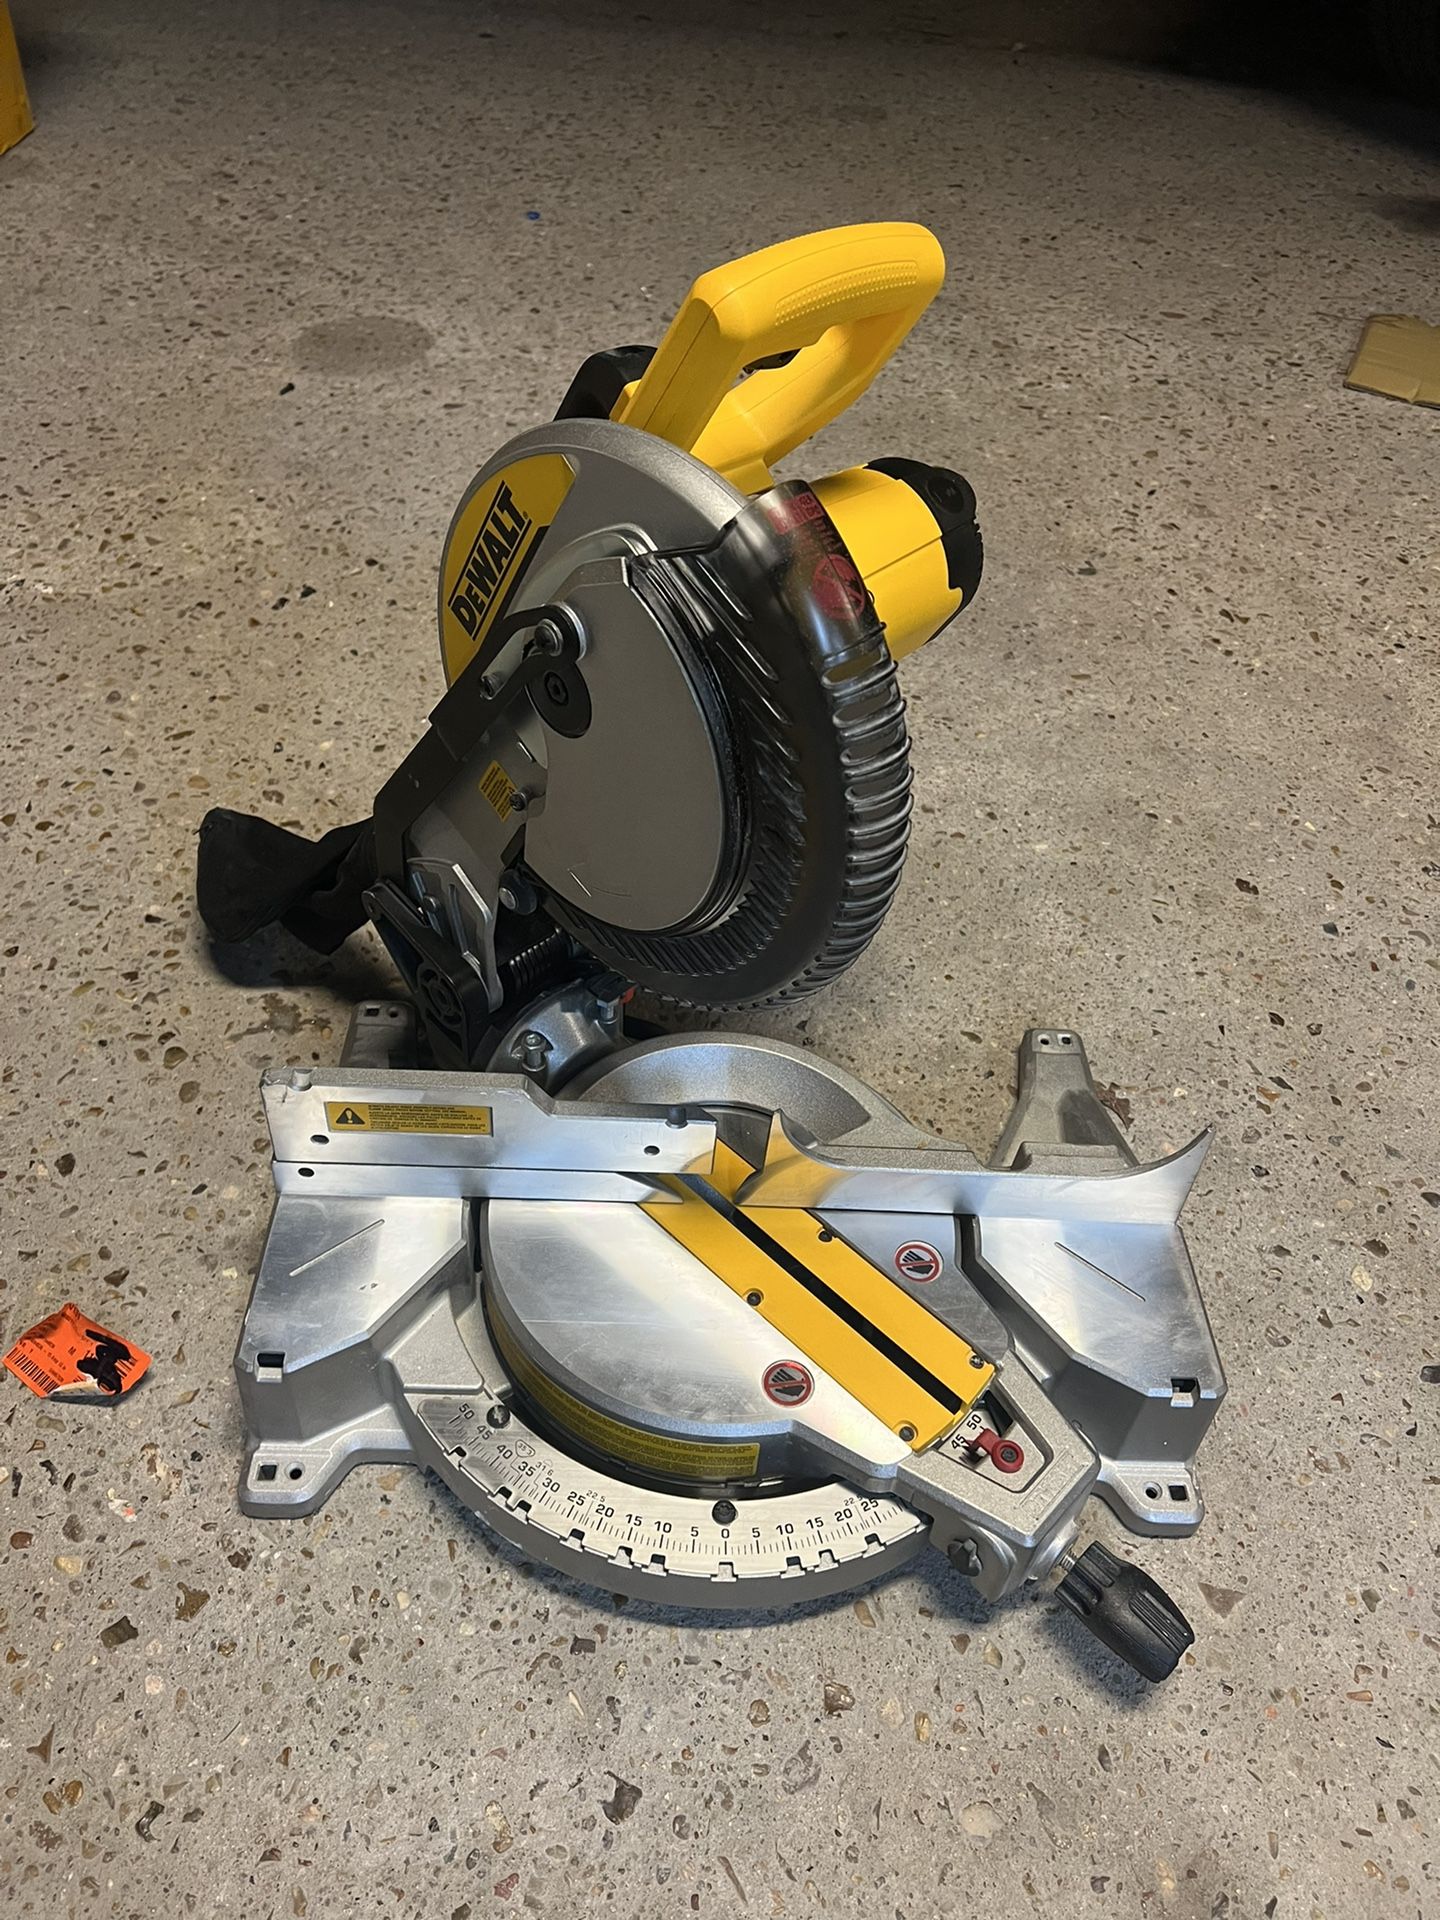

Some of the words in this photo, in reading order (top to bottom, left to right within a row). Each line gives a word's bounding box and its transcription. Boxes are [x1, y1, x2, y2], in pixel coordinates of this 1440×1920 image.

[451, 485, 526, 637] DEWALT
[967, 1414, 982, 1430] 50
[951, 1434, 966, 1450] 45
[459, 1403, 475, 1420] 50
[476, 1425, 493, 1440] 45
[497, 1445, 513, 1459] 40
[518, 1461, 536, 1477] 35
[542, 1477, 560, 1493] 30
[567, 1491, 586, 1506] 25
[595, 1504, 615, 1518] 20
[626, 1514, 643, 1526] 15
[654, 1521, 672, 1533] 10
[691, 1527, 699, 1537] 5
[721, 1528, 730, 1538] 0
[752, 1527, 761, 1538] 5
[776, 1523, 794, 1535] 10
[806, 1517, 824, 1529] 15
[834, 1508, 853, 1522] 20
[860, 1498, 879, 1512] 25
[535, 1461, 554, 1476] 316
